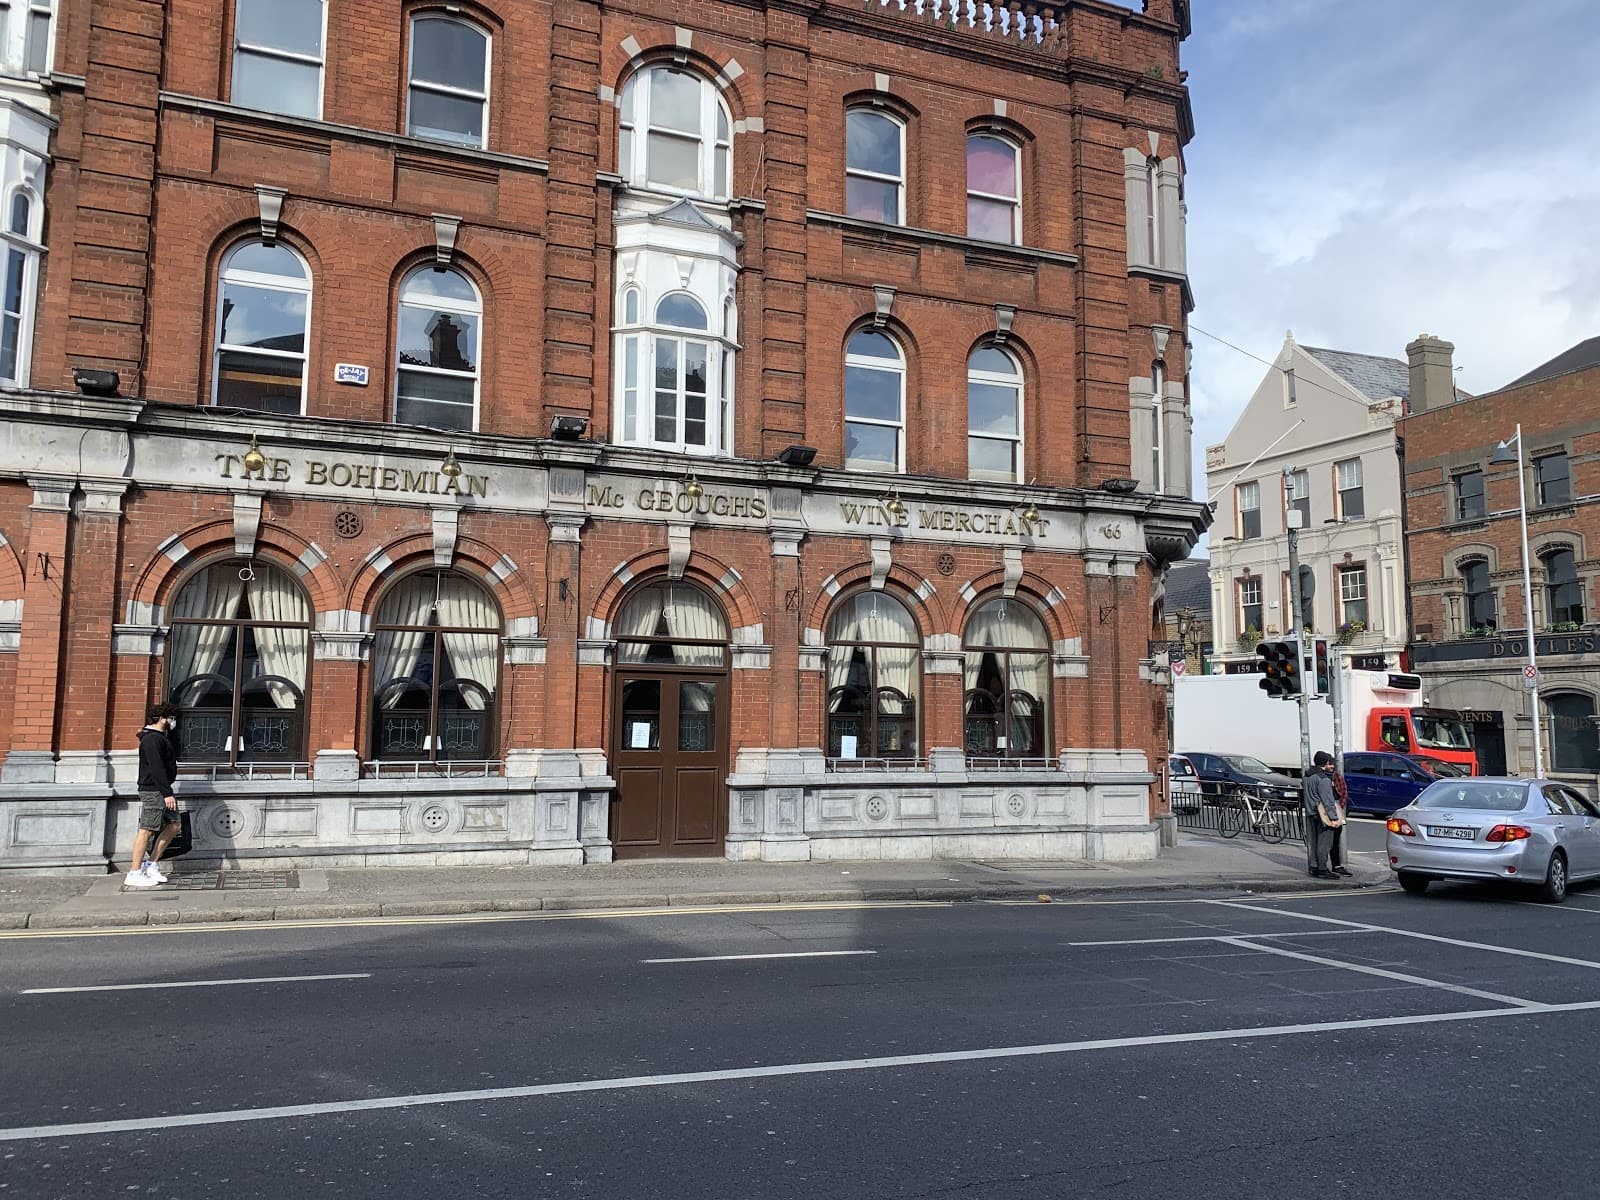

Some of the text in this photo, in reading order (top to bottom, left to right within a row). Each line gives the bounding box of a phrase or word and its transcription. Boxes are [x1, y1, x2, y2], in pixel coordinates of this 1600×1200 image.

[214, 453, 489, 498] THE BOHEMIAN
[587, 484, 768, 519] Mc GEOUGHS
[840, 503, 1051, 538] WINE MERCHANT
[1103, 523, 1122, 540] 66
[1492, 637, 1595, 656] DOYLE'S
[1236, 664, 1251, 673] 159
[1456, 711, 1493, 722] VENTS
